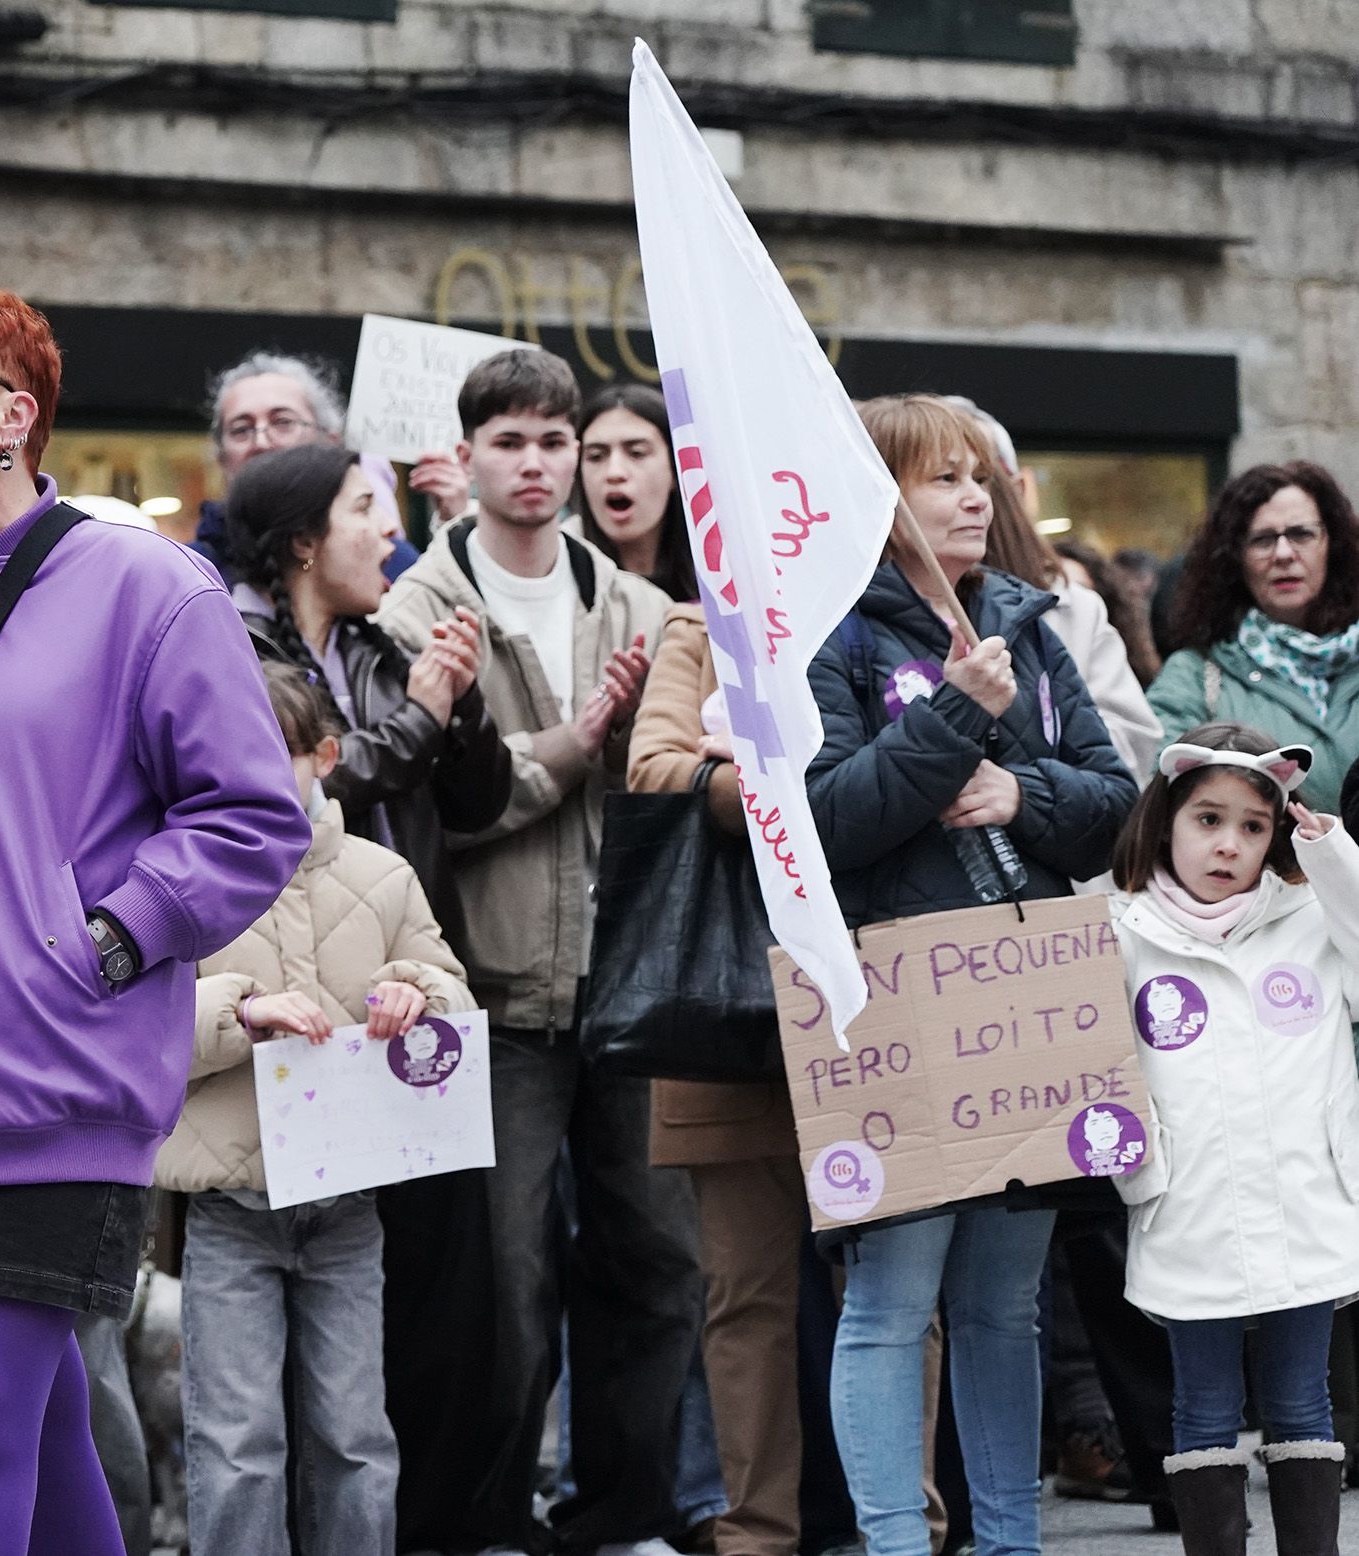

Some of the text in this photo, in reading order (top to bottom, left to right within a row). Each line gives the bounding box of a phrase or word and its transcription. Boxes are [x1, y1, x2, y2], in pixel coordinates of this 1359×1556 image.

[791, 952, 904, 1031] SN
[805, 1042, 912, 1107] PERO
[861, 1067, 1131, 1151] O GRANDE
